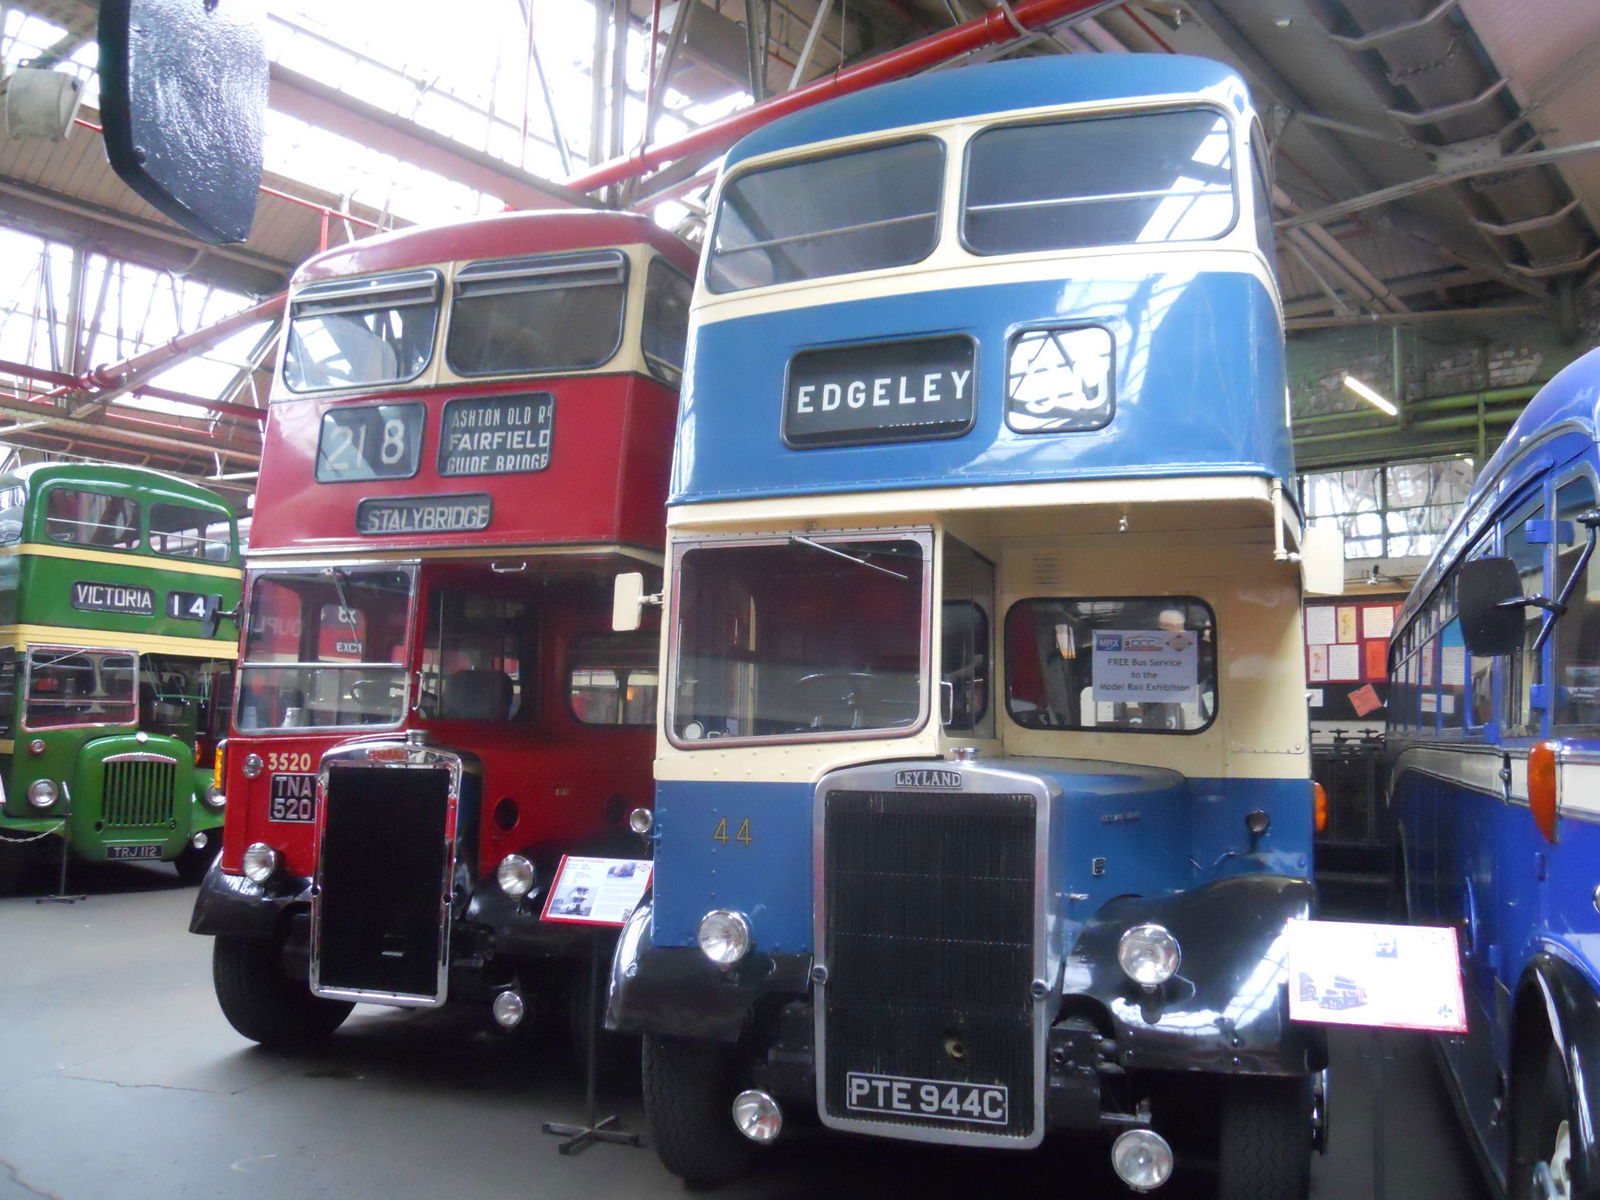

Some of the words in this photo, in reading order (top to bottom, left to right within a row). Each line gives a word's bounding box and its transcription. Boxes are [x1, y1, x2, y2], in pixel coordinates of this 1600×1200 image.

[796, 370, 971, 414] EDGELEY
[451, 408, 501, 429] ASHTON
[507, 407, 532, 426] OLD
[449, 429, 550, 452] FAIRFIELD
[367, 504, 489, 533] STALYBRIDGE
[77, 584, 152, 610] VICTORIA
[1108, 658, 1129, 666] FREE
[1132, 658, 1147, 666] Bus
[1150, 658, 1182, 667] Service
[1099, 683, 1124, 691] Model
[1127, 683, 1143, 691] Rail
[1146, 683, 1190, 691] Exhibition
[268, 752, 311, 772] 3520
[275, 777, 312, 797] TNA
[896, 770, 962, 787] LEYLAND
[273, 798, 311, 820] 520
[113, 846, 137, 858] TRJ
[140, 846, 157, 857] 112
[851, 1077, 912, 1111] PTE
[919, 1084, 1004, 1119] 944C
